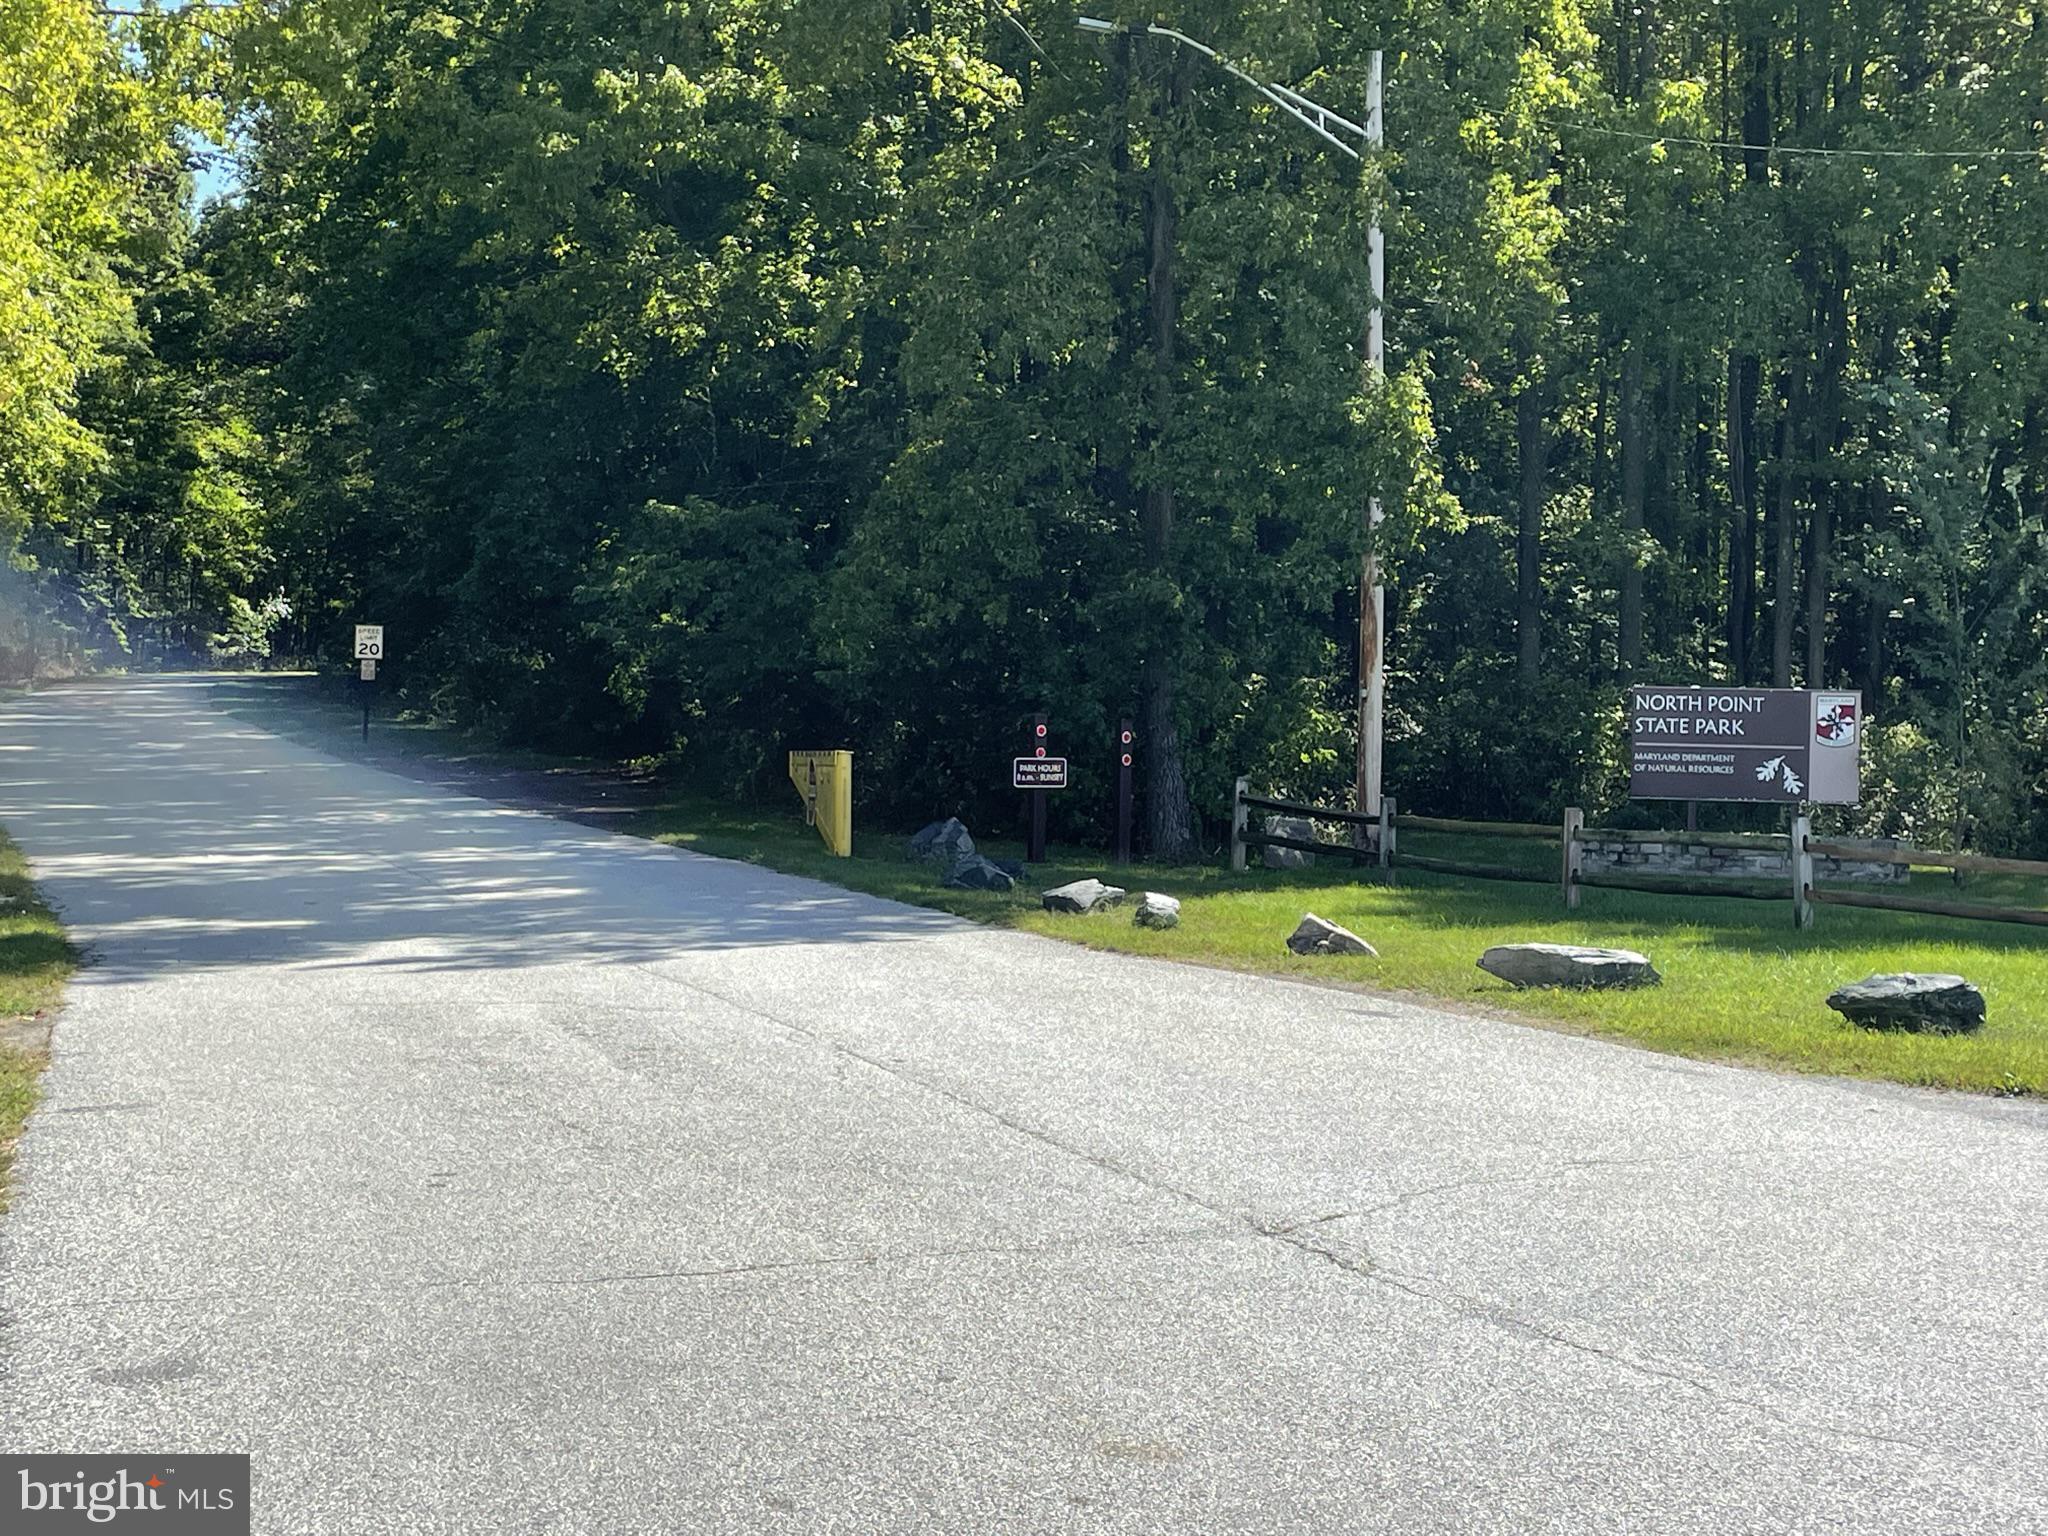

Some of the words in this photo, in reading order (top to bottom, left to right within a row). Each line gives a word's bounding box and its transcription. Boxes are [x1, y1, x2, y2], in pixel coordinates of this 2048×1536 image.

[358, 643, 380, 656] 20
[1635, 694, 1702, 712] NORTH
[1708, 696, 1765, 713] POINT
[1634, 717, 1690, 735] STATE
[1695, 718, 1745, 736] PARK
[1634, 752, 1681, 763] MARYLAND
[1682, 753, 1735, 764] DEPARTMENT
[1019, 764, 1037, 772] PARK
[1634, 763, 1646, 773] OF
[1647, 764, 1687, 774] NATURAL
[1687, 764, 1735, 775] RESOURCES
[1040, 773, 1064, 781] SUNSET
